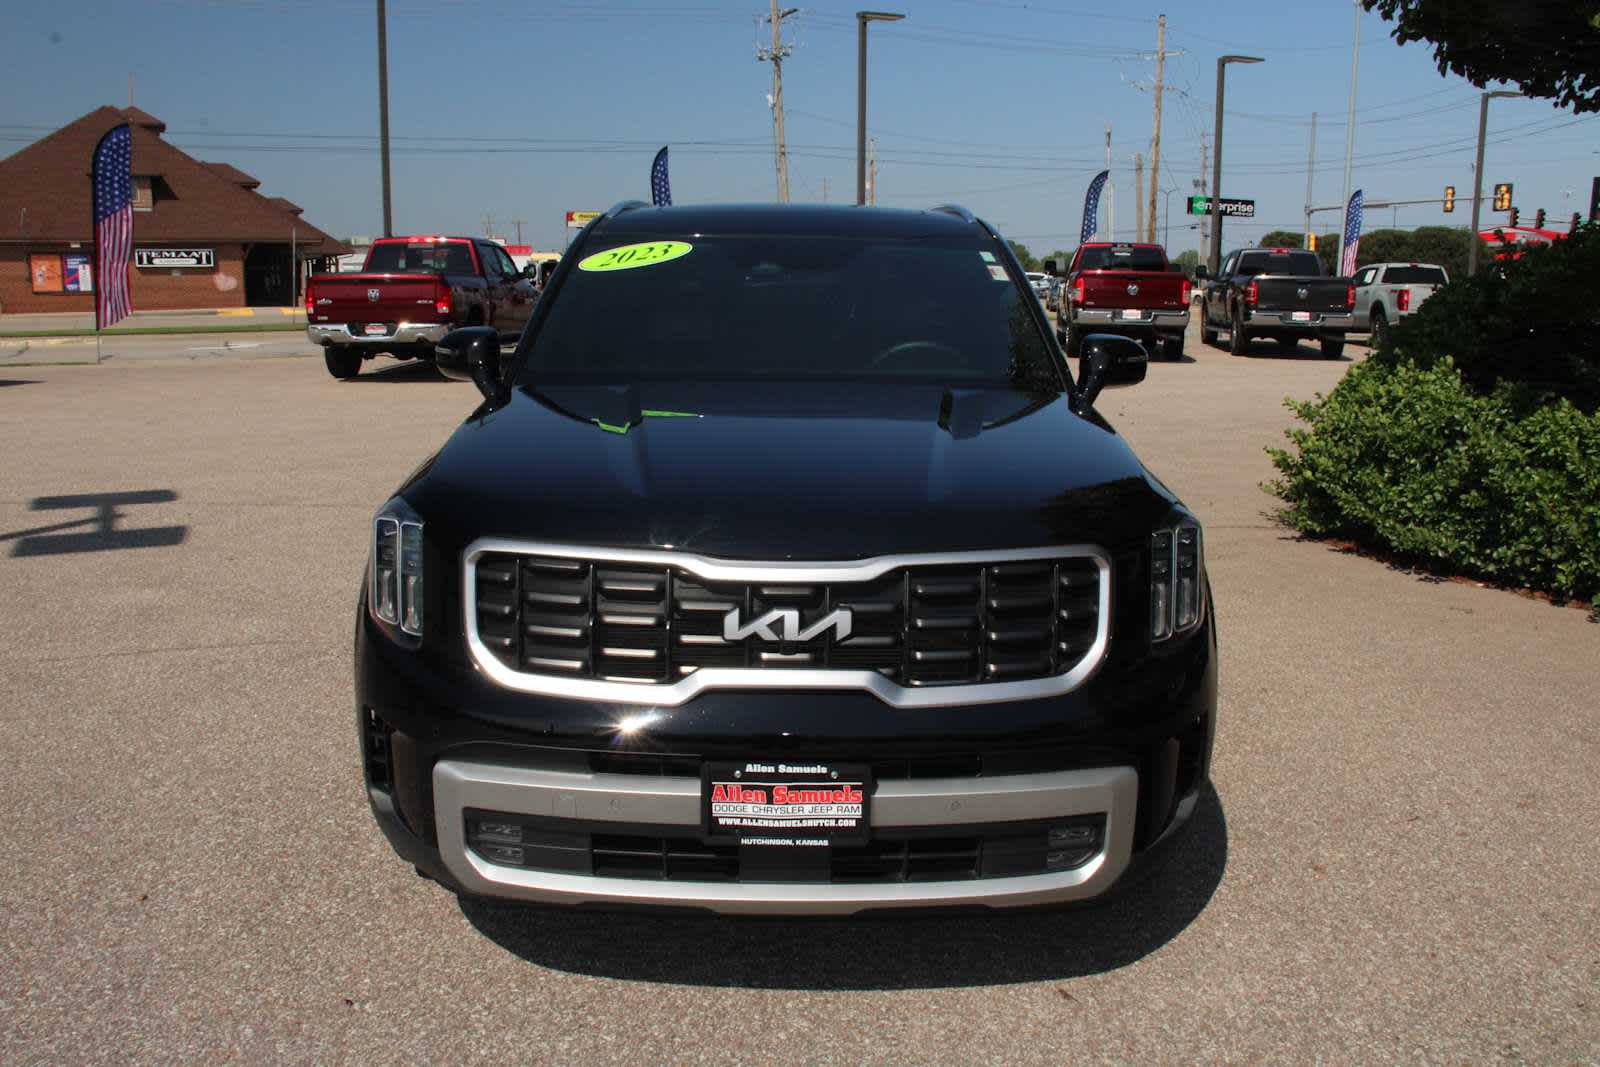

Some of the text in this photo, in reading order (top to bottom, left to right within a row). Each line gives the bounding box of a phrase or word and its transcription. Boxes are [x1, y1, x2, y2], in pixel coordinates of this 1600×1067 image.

[138, 251, 210, 265] TEMAAT
[597, 244, 673, 267] 2023
[723, 607, 853, 641] KIA
[745, 763, 828, 774] Allen Samuels
[711, 784, 863, 804] Allen Samuels
[714, 804, 861, 814] DODGE CHRYSLER JEEP RAM
[741, 838, 795, 846] HUTCHINSON,
